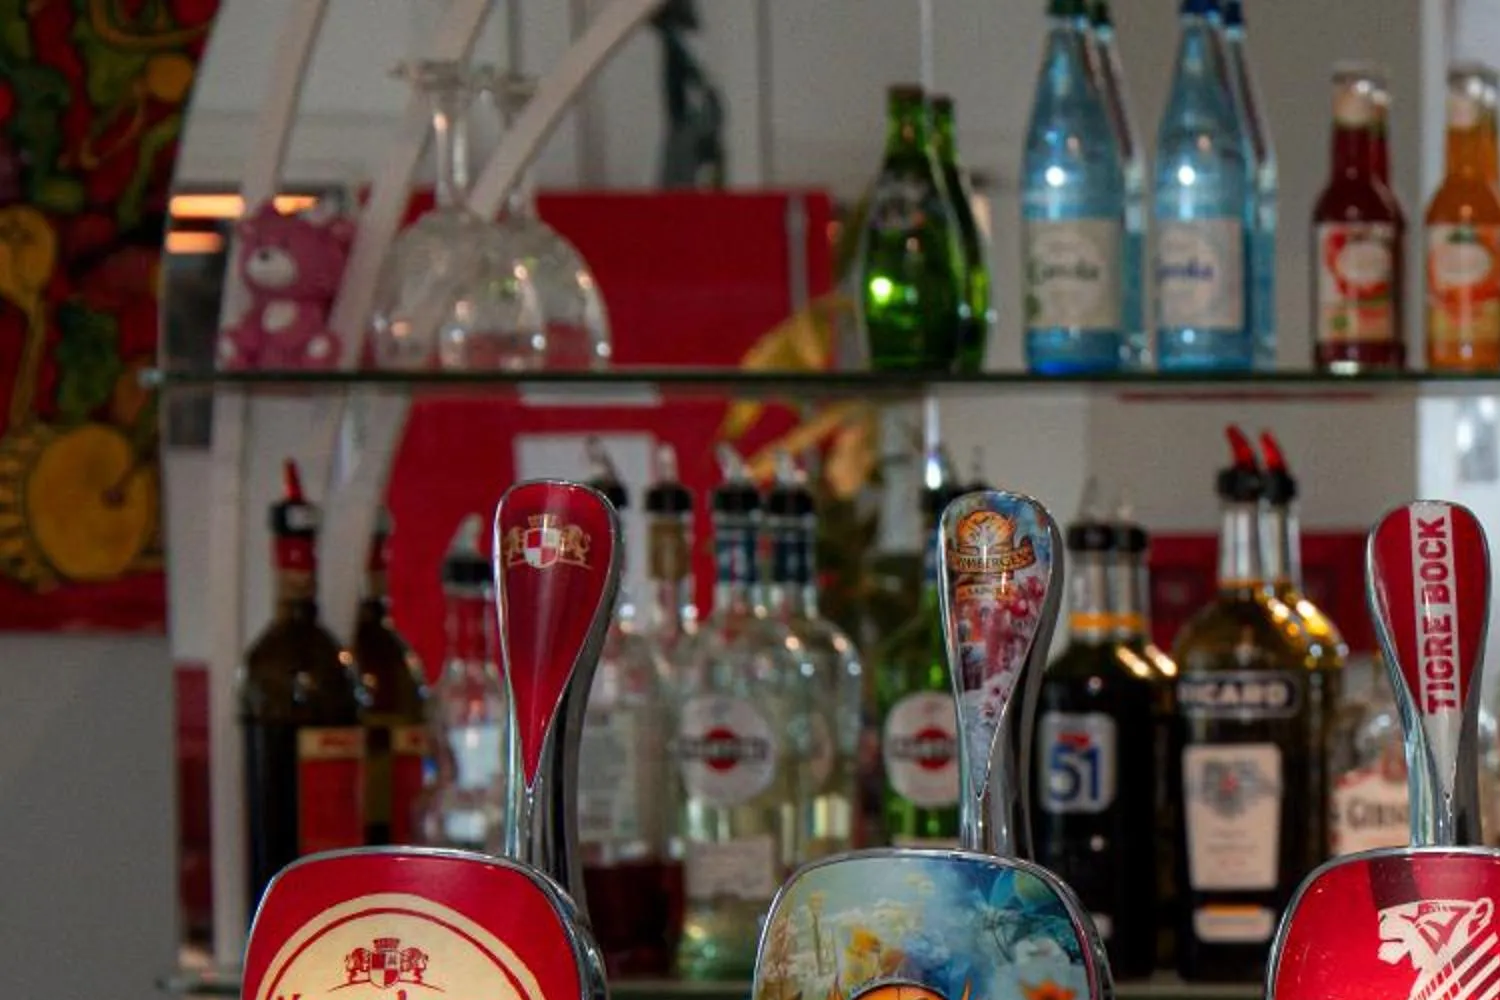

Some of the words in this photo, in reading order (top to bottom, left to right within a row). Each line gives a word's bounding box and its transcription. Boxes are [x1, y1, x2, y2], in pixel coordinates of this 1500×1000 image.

[1417, 516, 1450, 605] BOCK
[1423, 613, 1456, 714] TIGRE
[1049, 744, 1101, 802] 51
